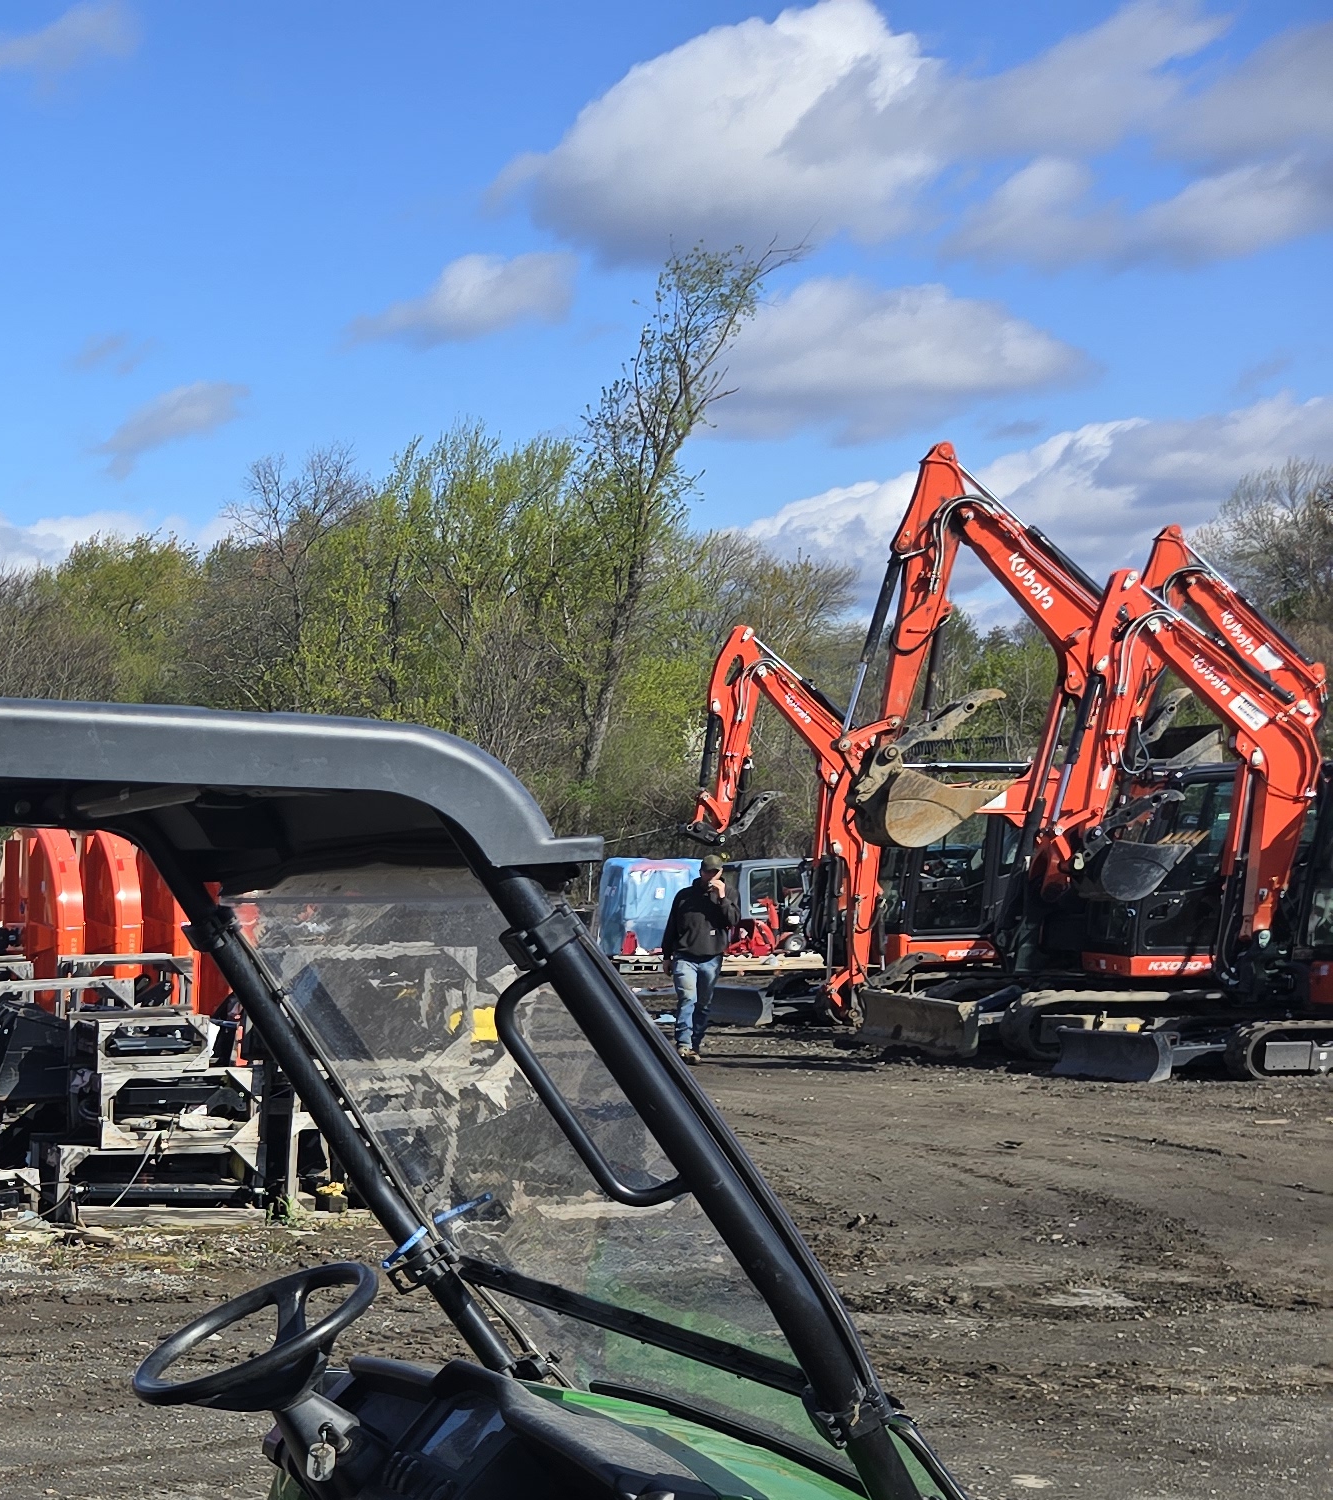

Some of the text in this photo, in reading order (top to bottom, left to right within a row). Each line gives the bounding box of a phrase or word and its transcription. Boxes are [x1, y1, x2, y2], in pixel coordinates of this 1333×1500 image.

[1007, 552, 1053, 610] Kubota
[1221, 609, 1255, 655] Kubota
[1191, 654, 1231, 696] Kubota
